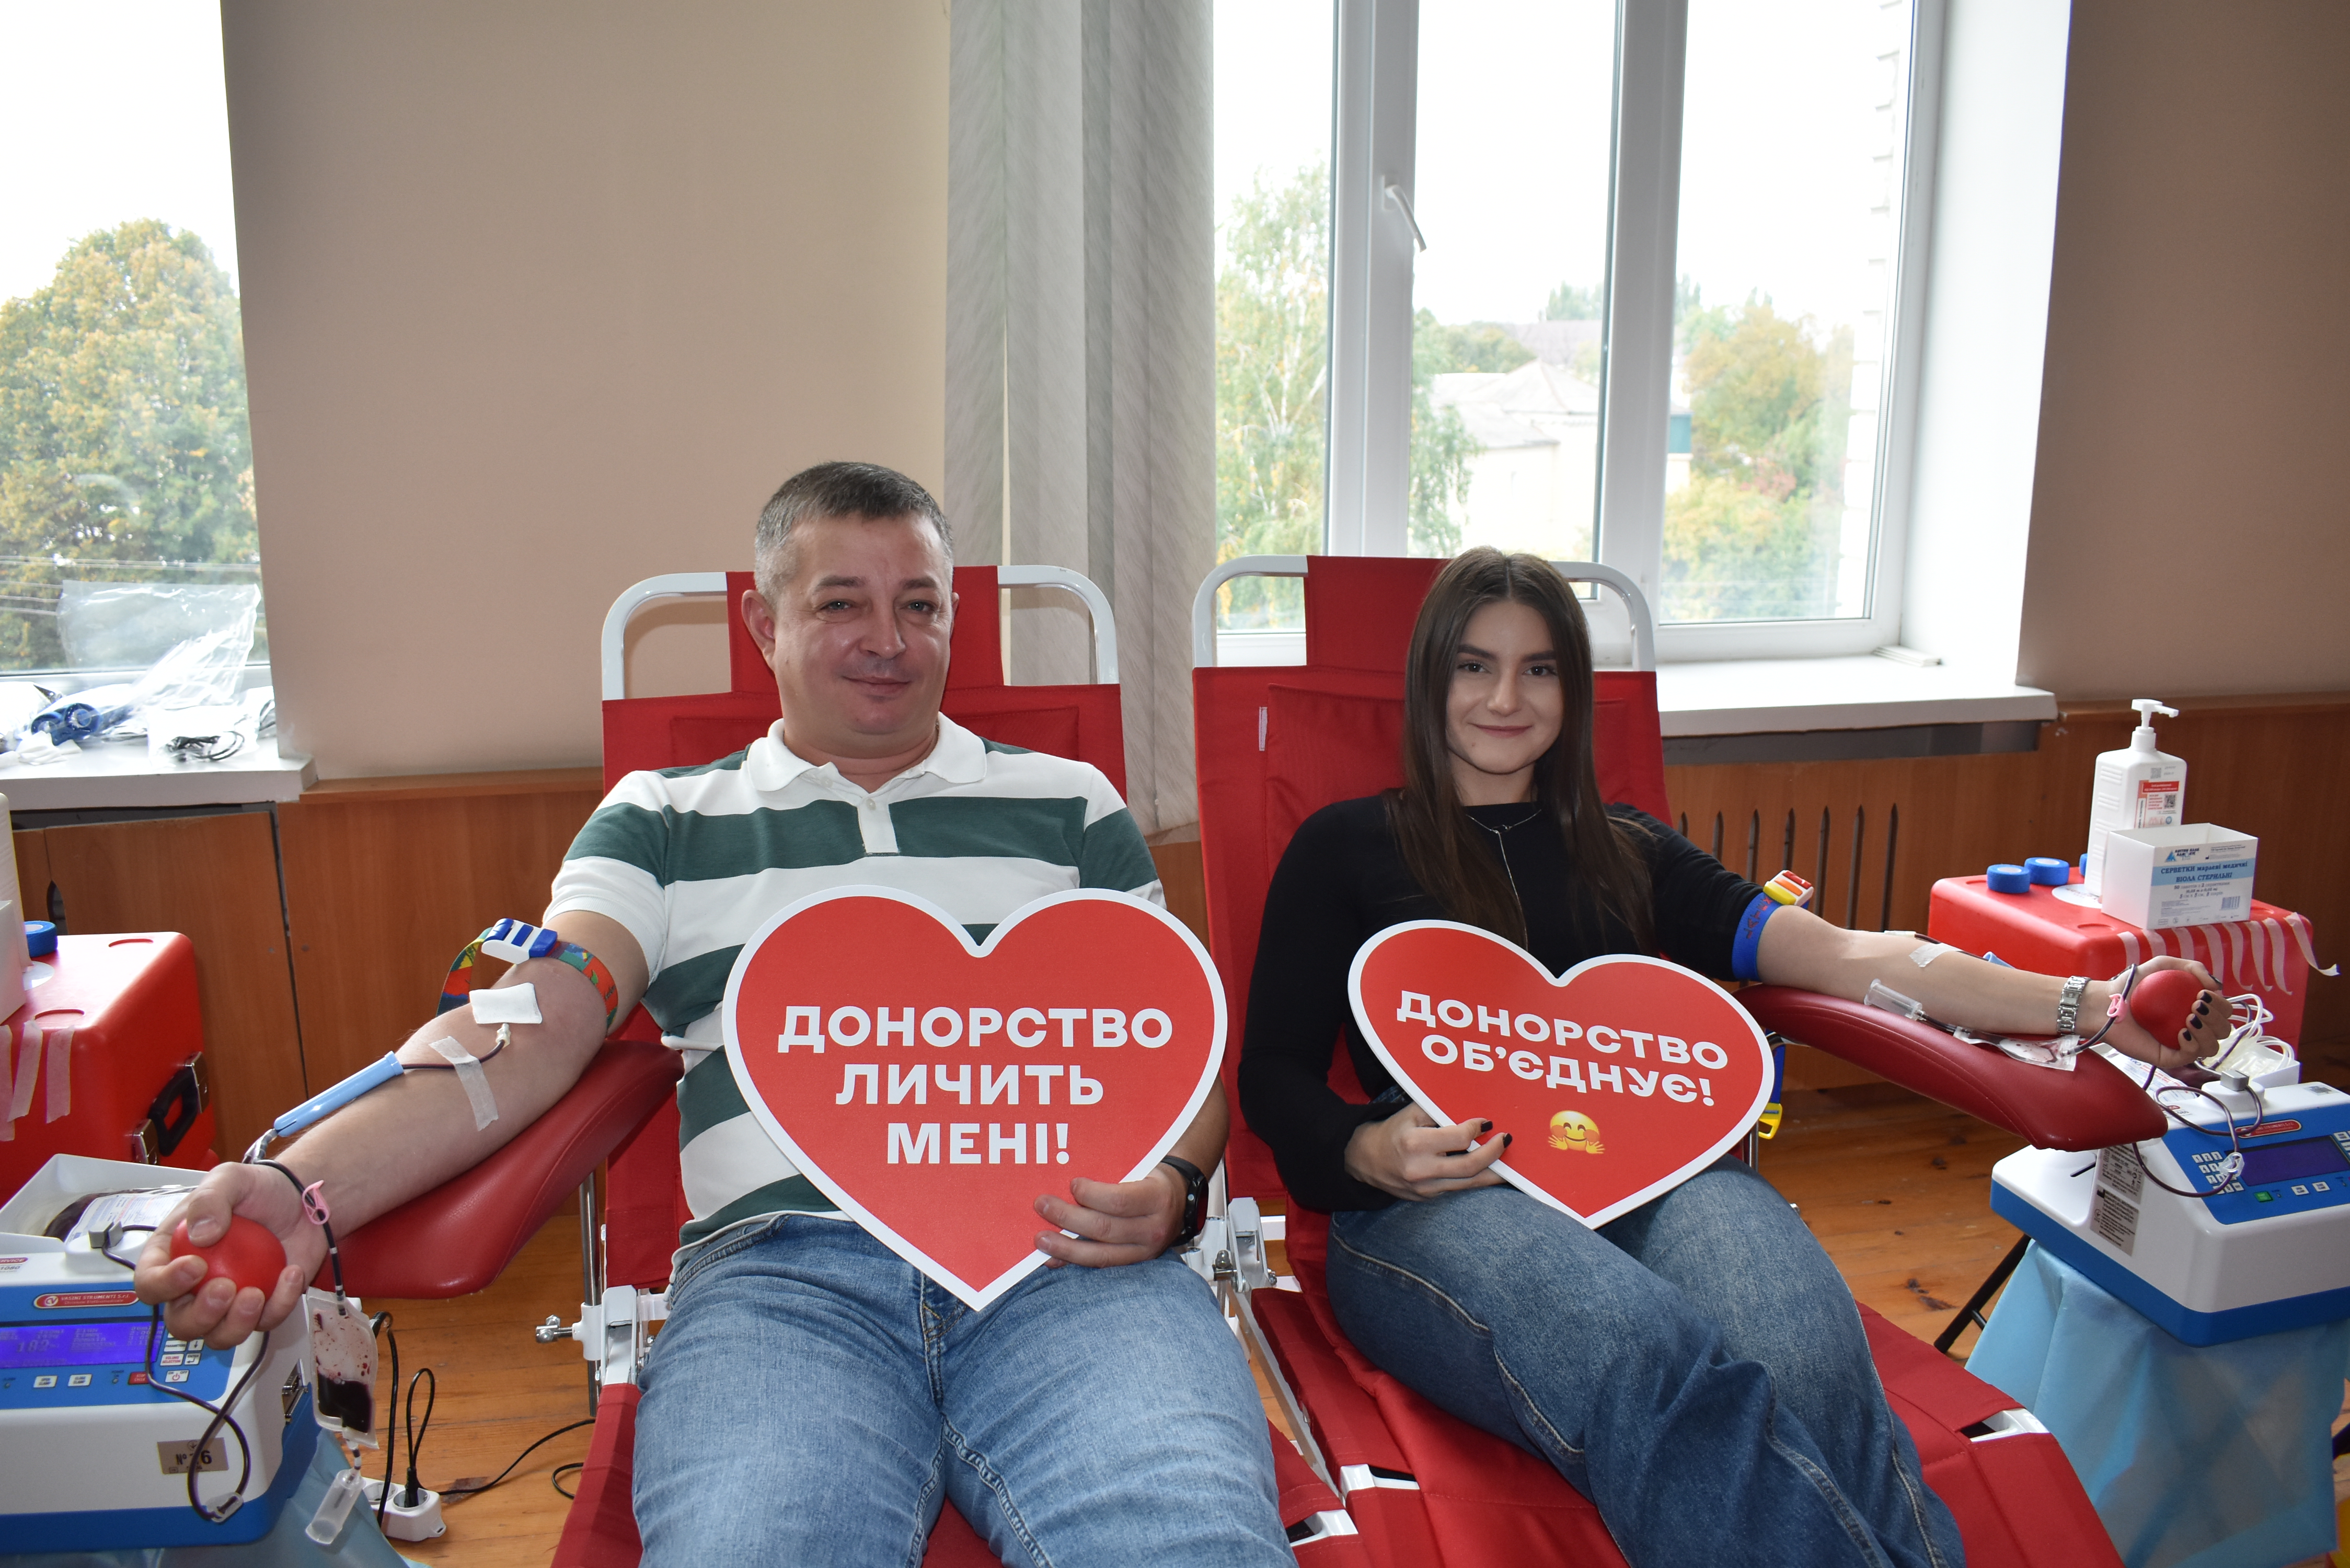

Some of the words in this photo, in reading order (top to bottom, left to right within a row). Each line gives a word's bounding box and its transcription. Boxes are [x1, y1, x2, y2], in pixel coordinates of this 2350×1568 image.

[2197, 872, 2233, 881] СТЕРИЛЬНІ
[778, 1006, 1172, 1053] ДОНОРСТВО
[1397, 990, 1728, 1069] ДОНОРСТВО
[836, 1064, 1103, 1105] ЛИЧИТЬ
[1421, 1034, 1714, 1106] ОБ’ЄДНУЄ!
[887, 1123, 1069, 1164] МЕНІ!
